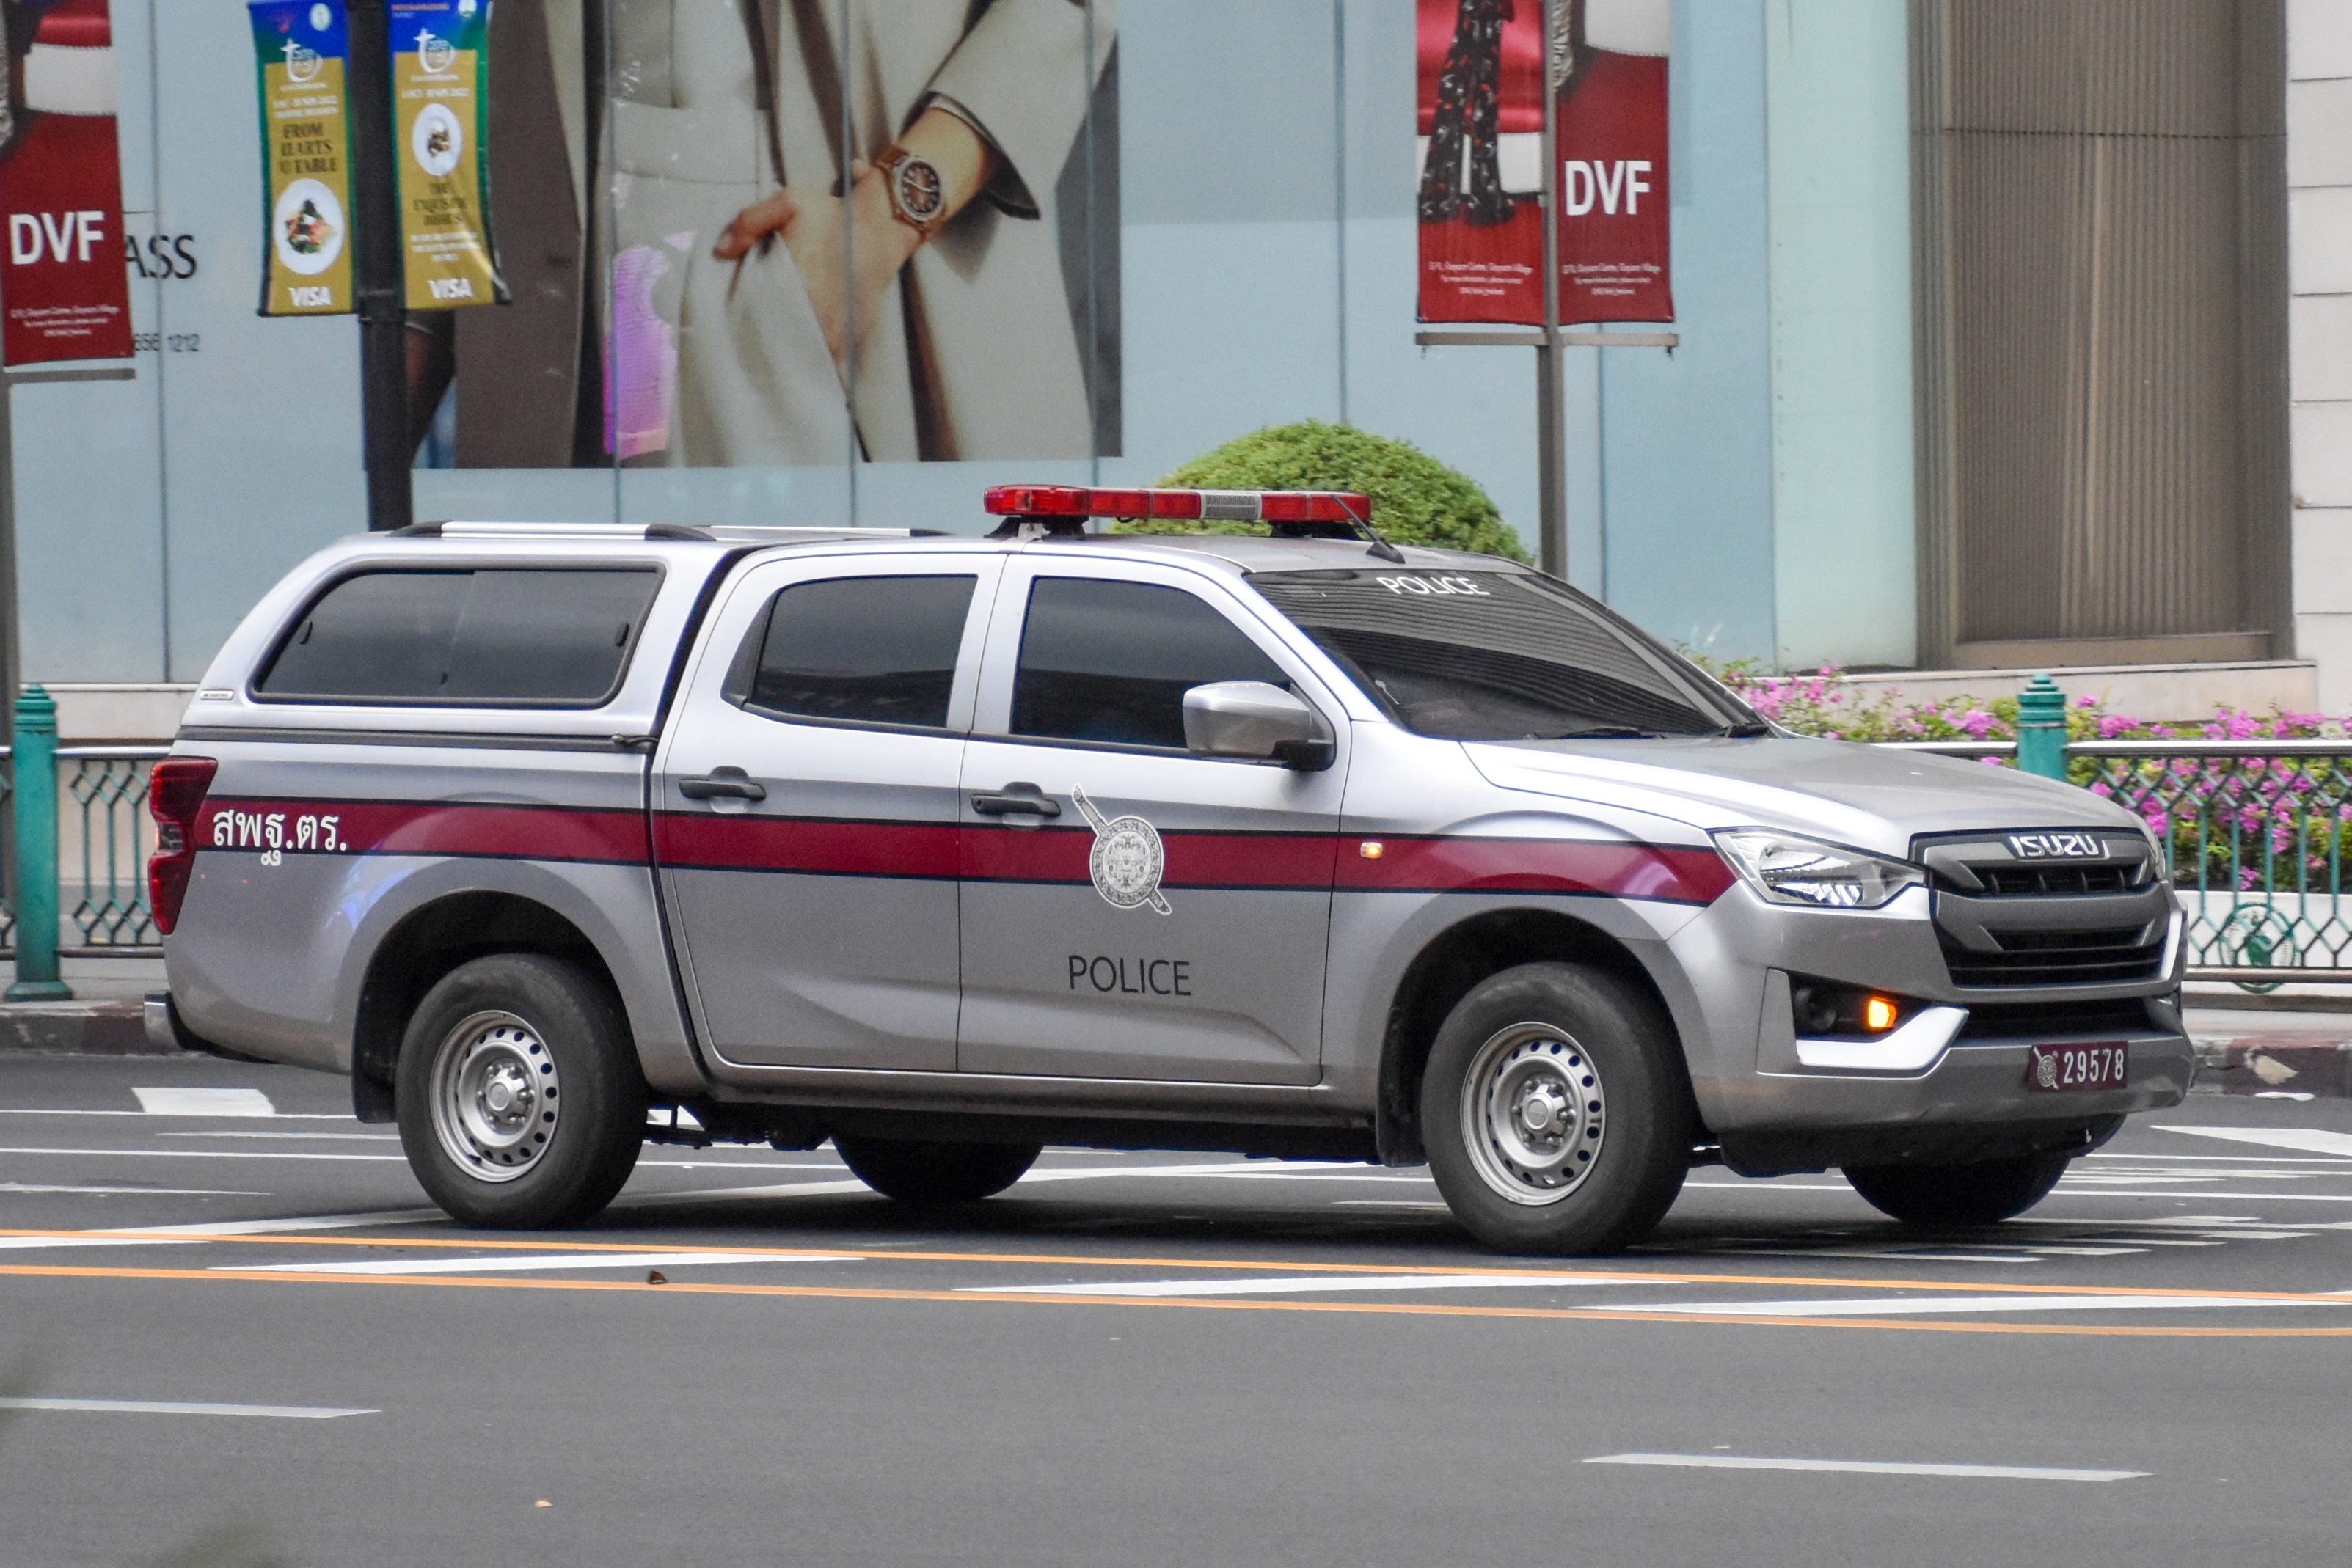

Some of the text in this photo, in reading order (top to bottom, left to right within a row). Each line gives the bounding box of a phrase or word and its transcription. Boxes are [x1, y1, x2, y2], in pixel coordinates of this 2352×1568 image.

[1565, 160, 1652, 216] DVF
[9, 210, 105, 265] DVF
[287, 286, 332, 307] VISA
[428, 278, 474, 299] VISA
[1376, 576, 1490, 595] POLICE
[213, 810, 347, 866] สพฐ.ตร.
[2009, 835, 2099, 857] ISUZU
[1069, 955, 1191, 996] POLICE
[2064, 1049, 2124, 1083] 29578
